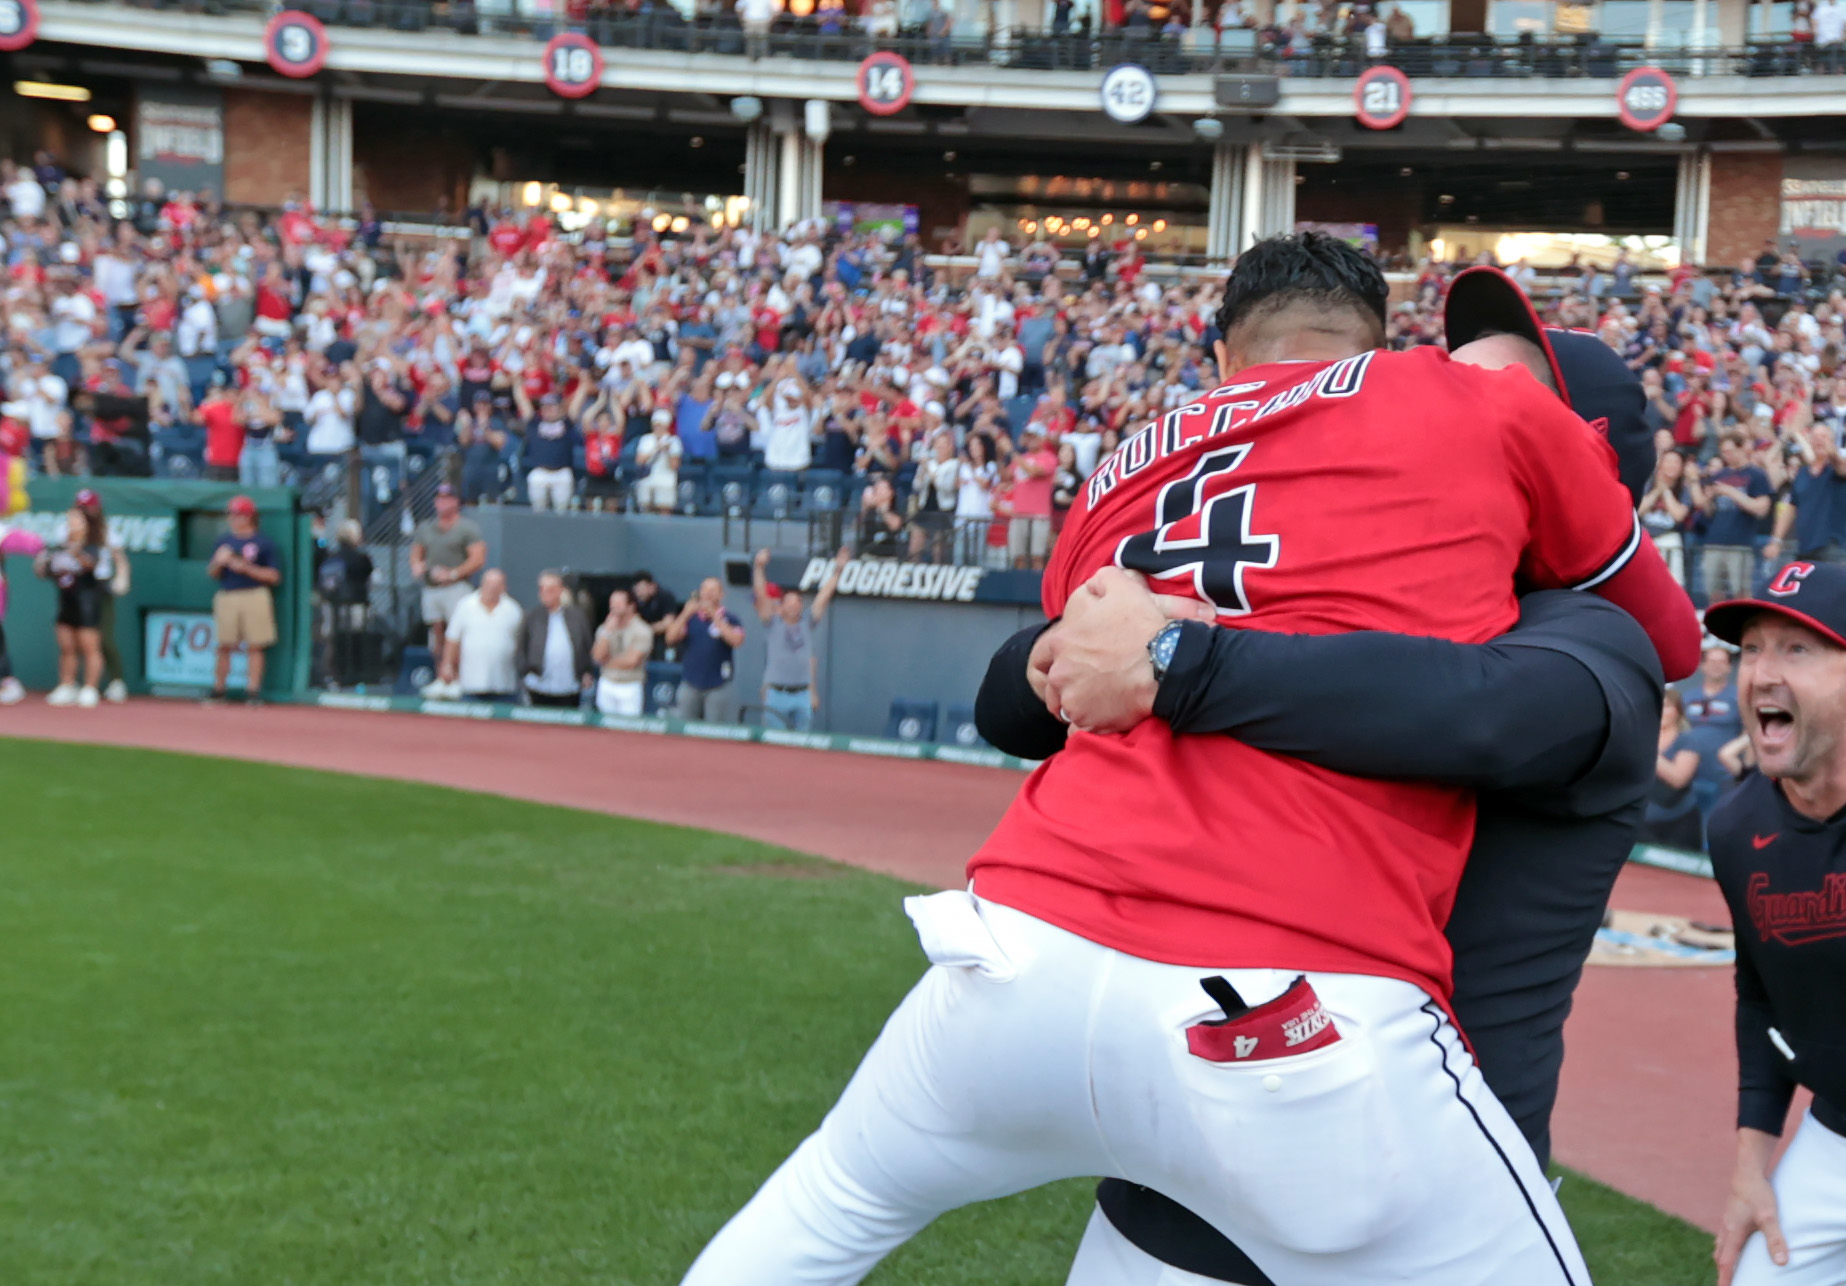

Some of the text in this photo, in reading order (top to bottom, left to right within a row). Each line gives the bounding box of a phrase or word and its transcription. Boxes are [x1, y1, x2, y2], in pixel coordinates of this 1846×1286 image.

[865, 66, 903, 100] 14
[1108, 78, 1147, 107] 42
[1363, 81, 1400, 113] 21
[1624, 86, 1667, 110] 455
[1113, 441, 1280, 616] 4
[1768, 561, 1816, 598] C
